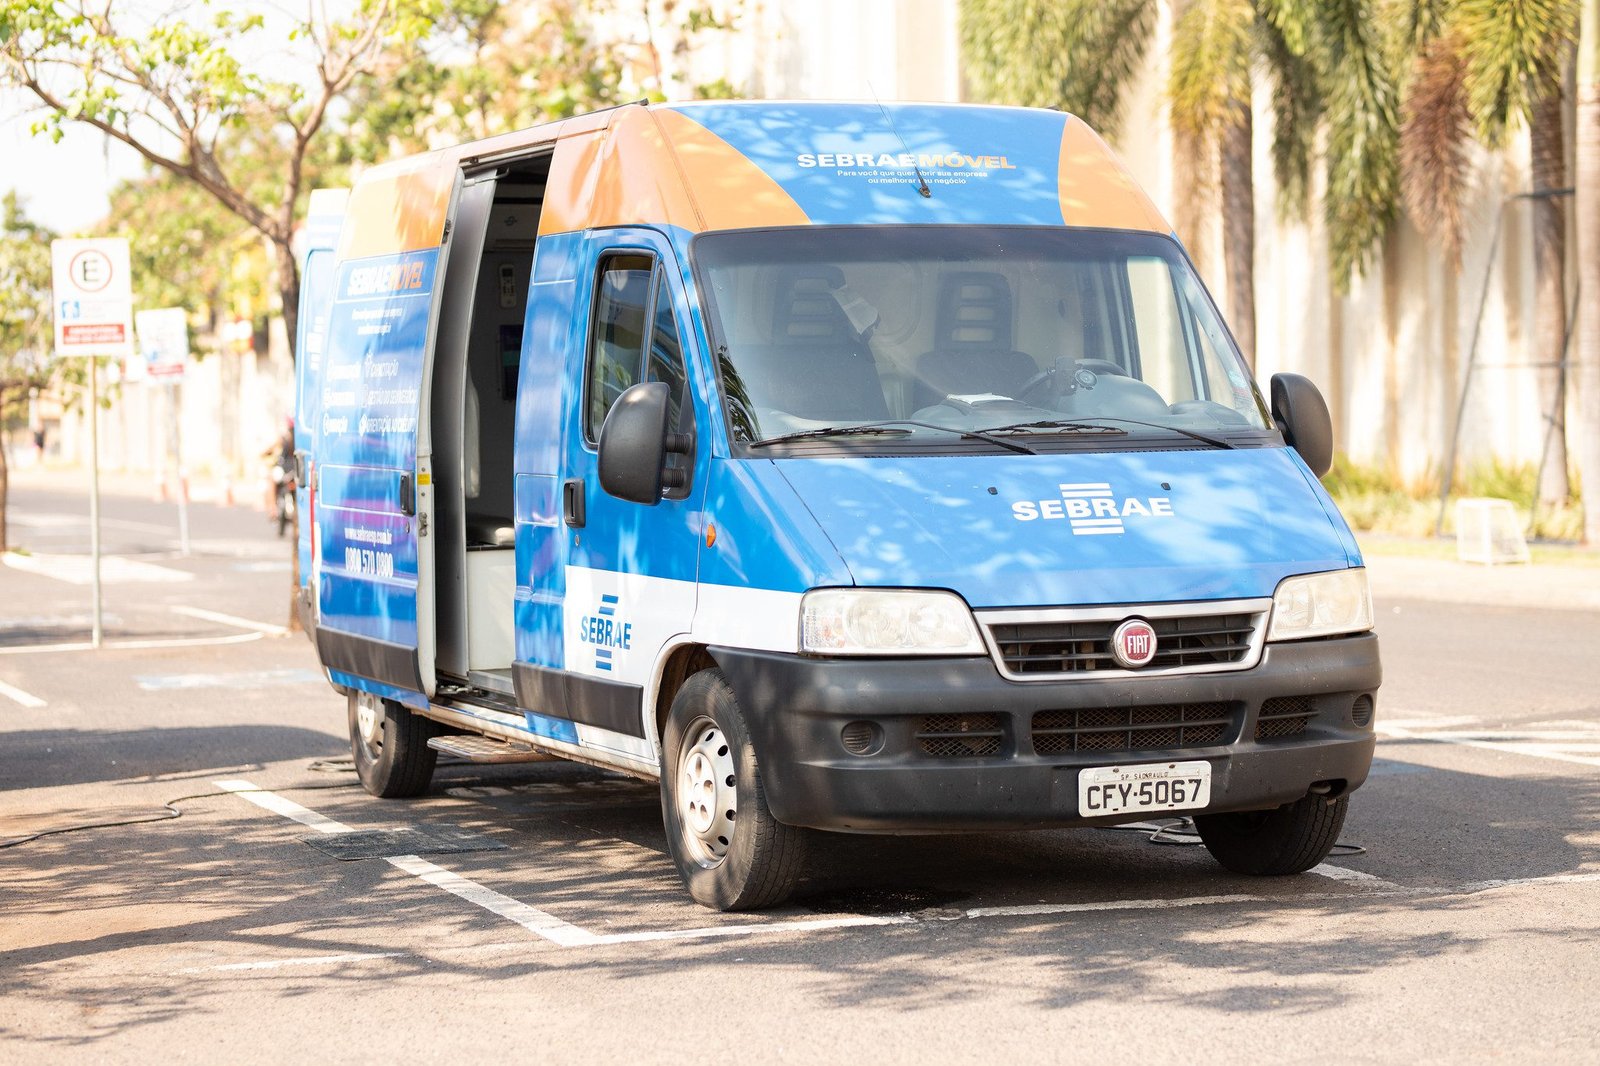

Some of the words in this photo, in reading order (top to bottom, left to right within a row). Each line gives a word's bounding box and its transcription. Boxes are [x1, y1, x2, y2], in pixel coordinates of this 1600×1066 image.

[83, 260, 99, 282] E
[1011, 497, 1175, 521] SEBRAE
[345, 546, 362, 573] 0800
[362, 549, 375, 575] 570
[376, 551, 394, 578] 0800
[580, 615, 632, 650] SEBRAE
[1127, 634, 1149, 654] FIAT
